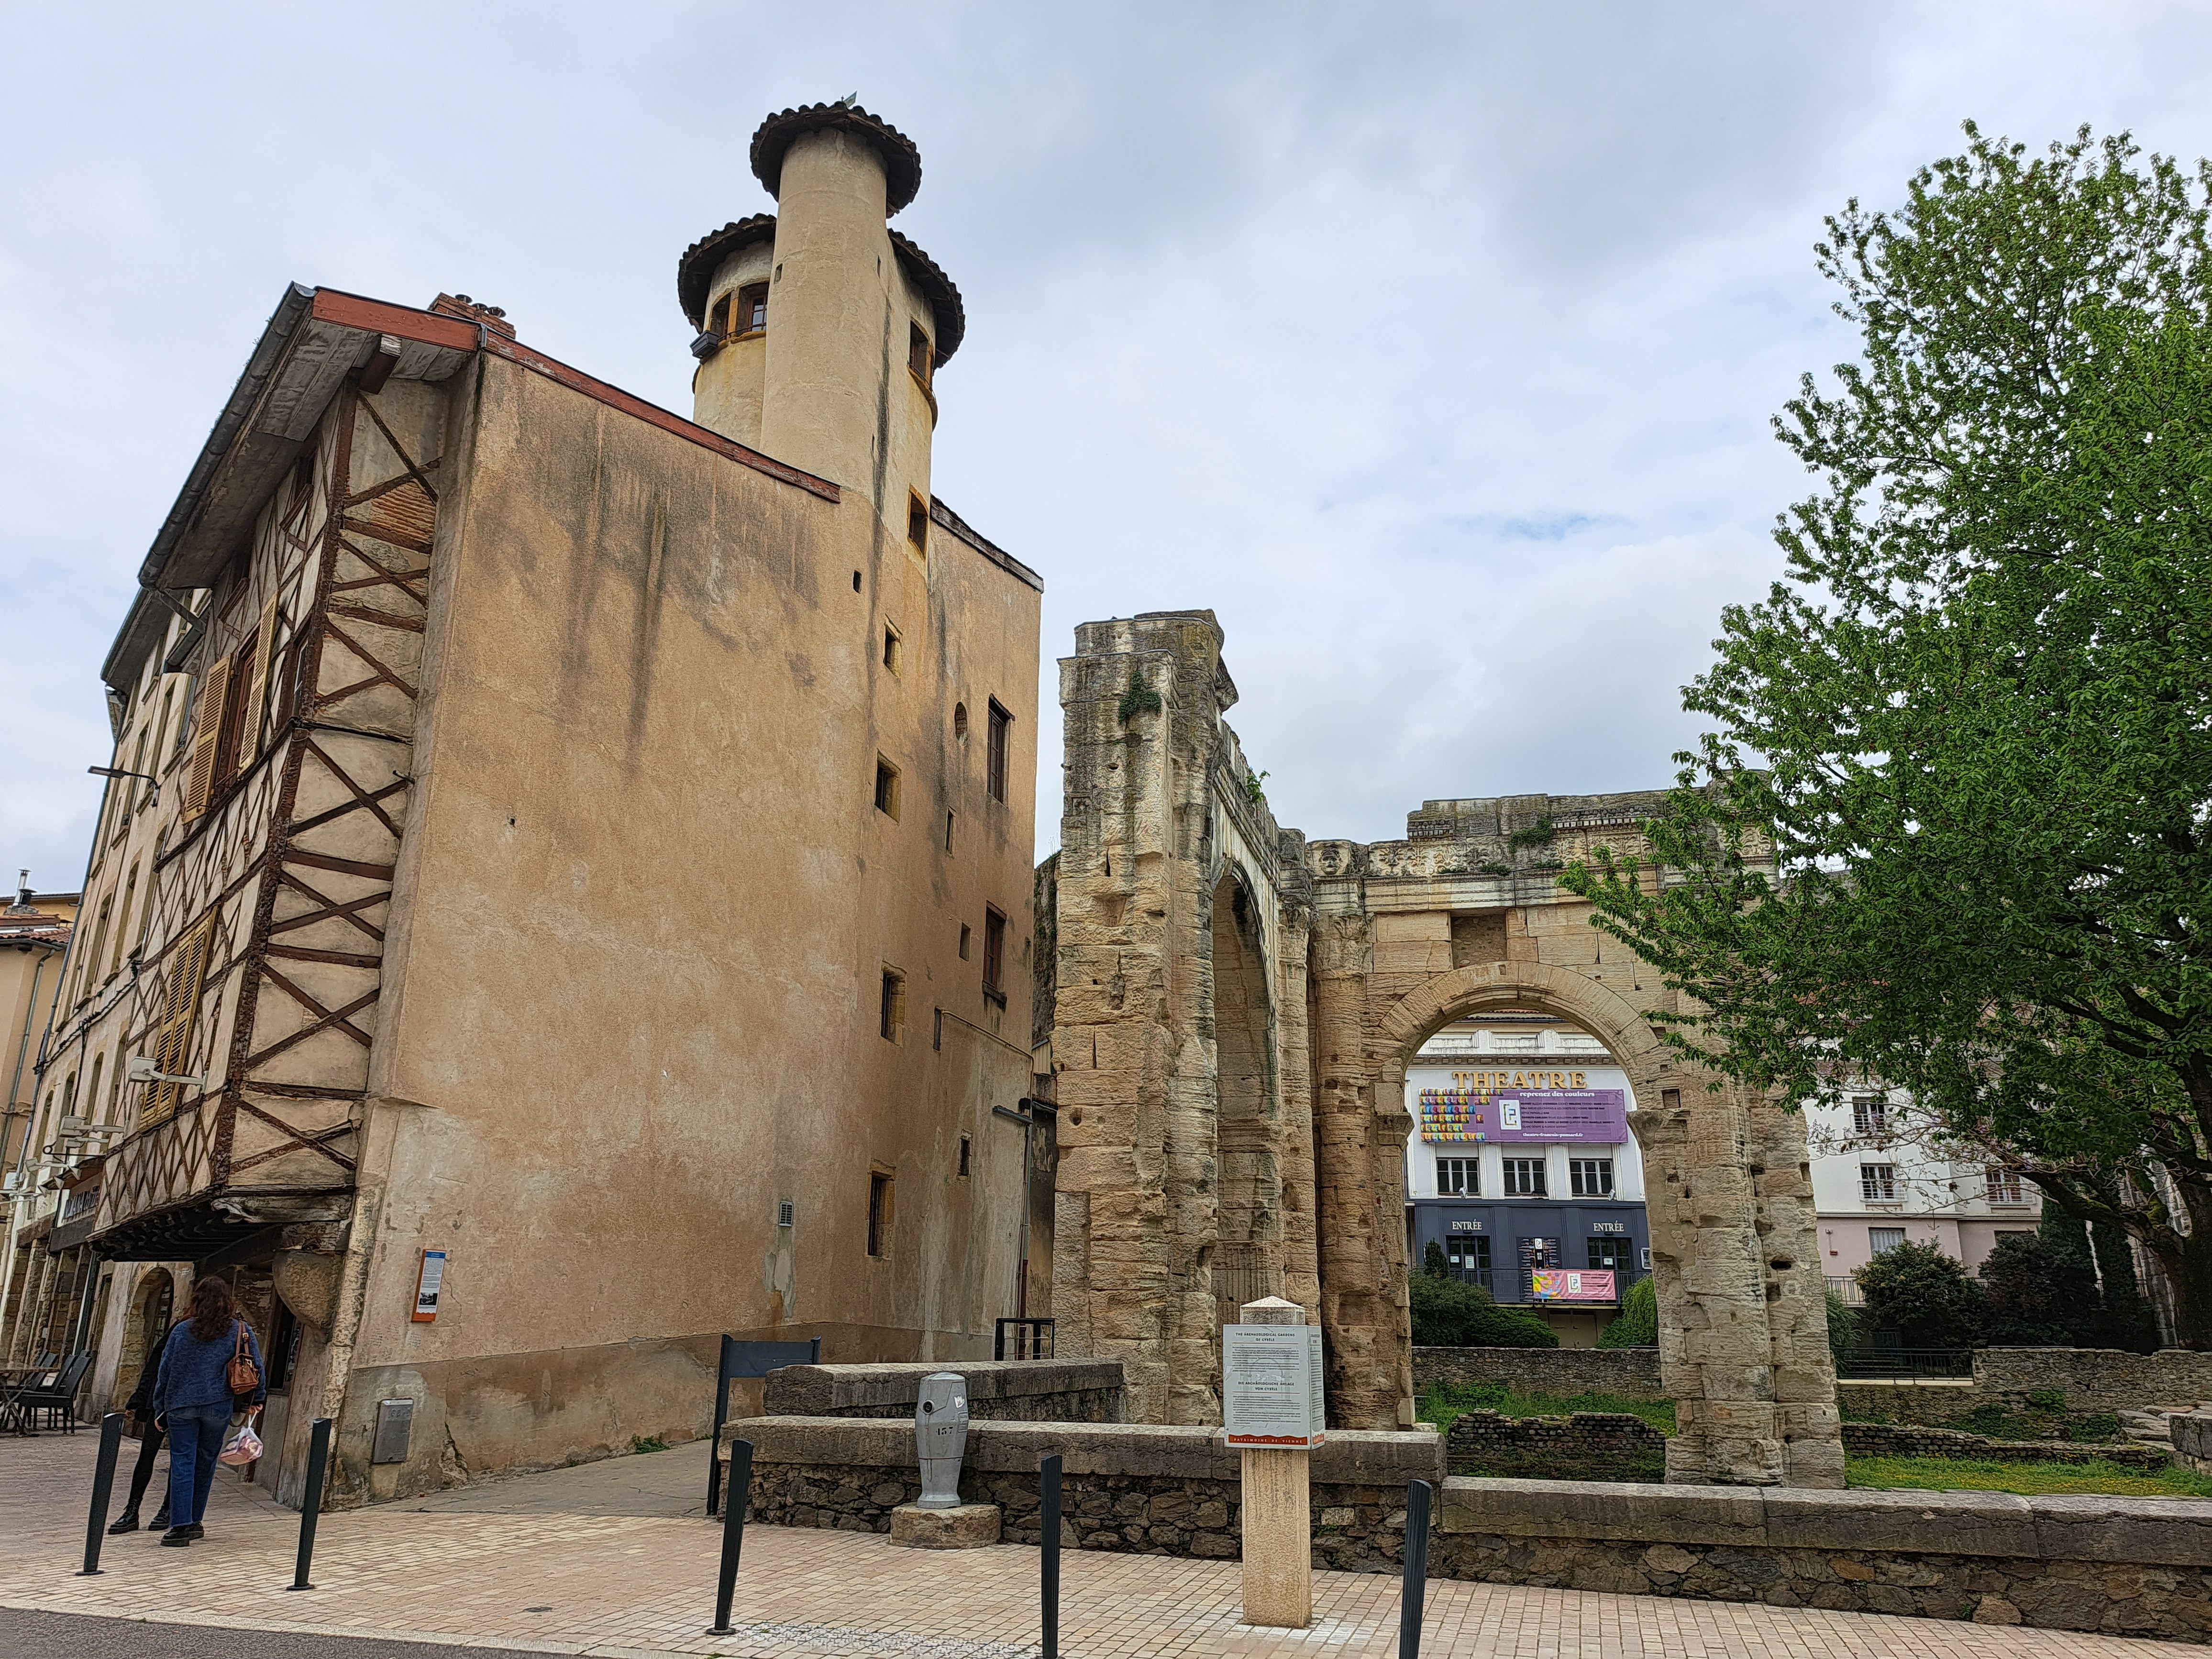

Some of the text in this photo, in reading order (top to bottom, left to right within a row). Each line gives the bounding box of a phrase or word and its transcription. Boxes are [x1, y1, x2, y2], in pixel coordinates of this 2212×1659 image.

[1452, 1071, 1587, 1089] THEATRE
[1451, 1218, 1482, 1230] ENTRÉE
[1593, 1220, 1624, 1232] ENTRÉE
[936, 1427, 953, 1436] 157
